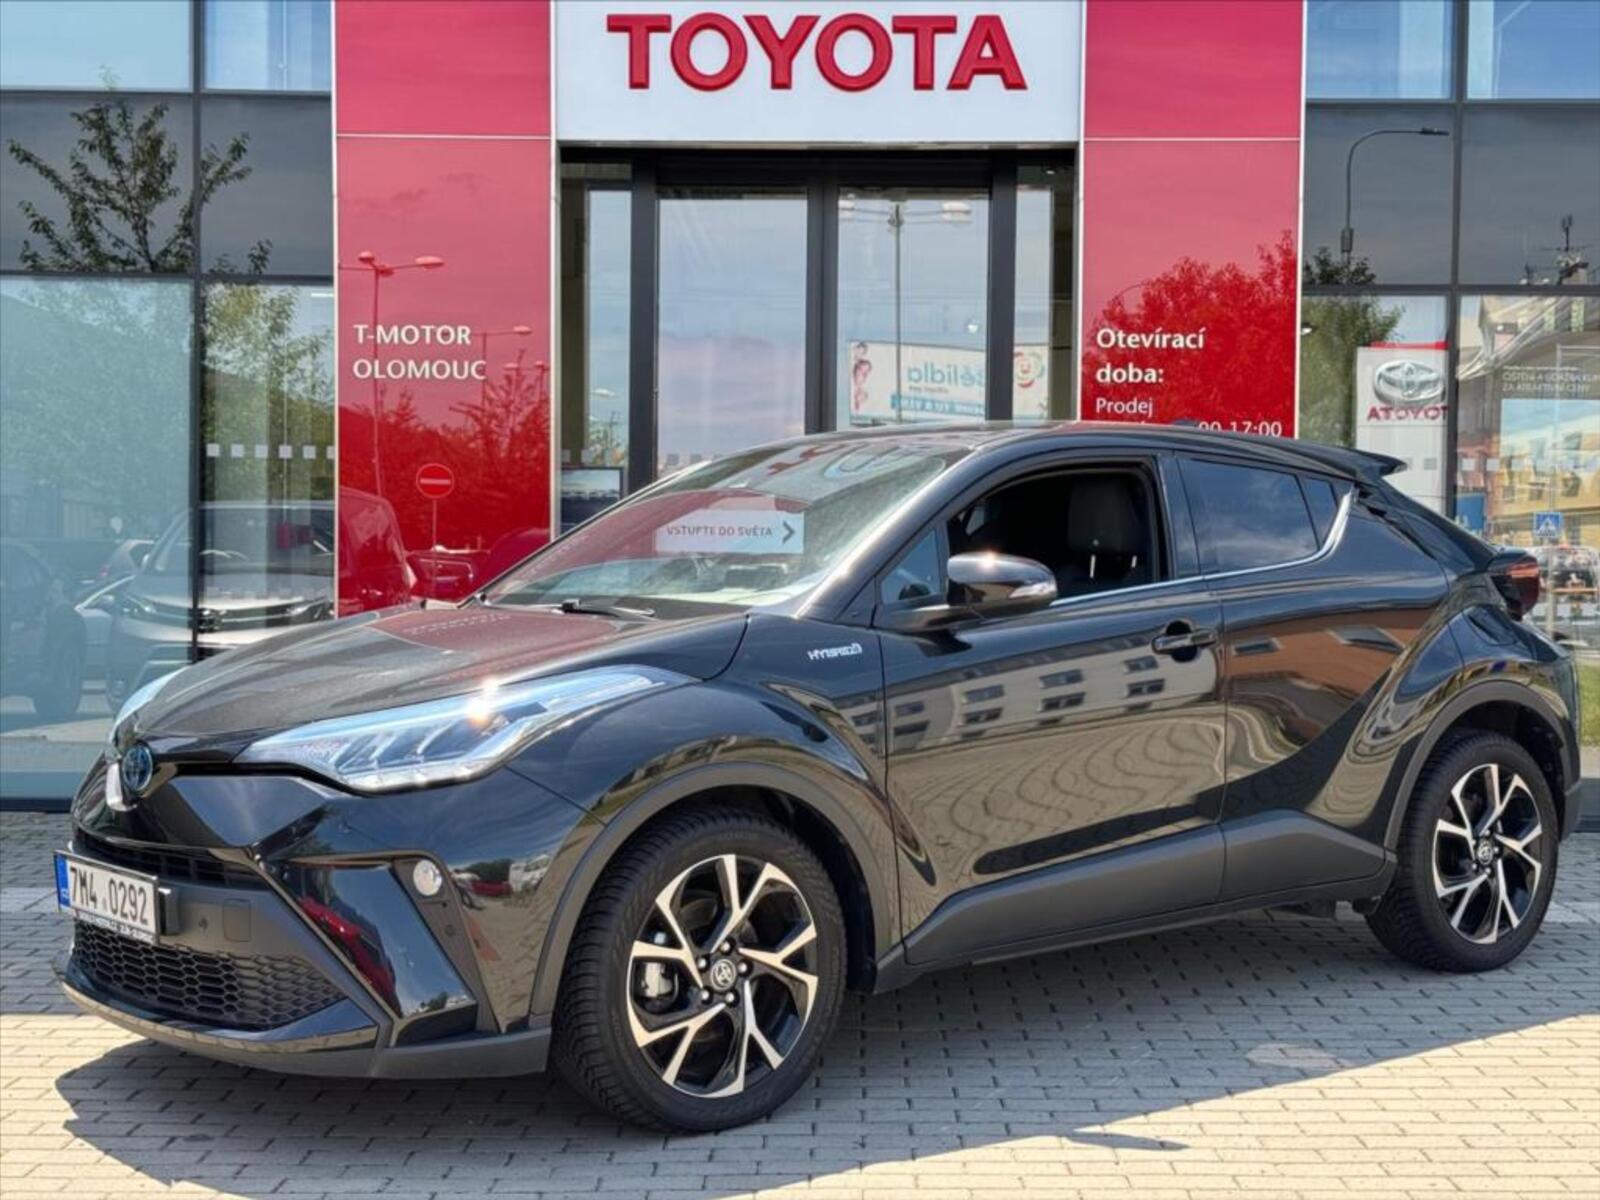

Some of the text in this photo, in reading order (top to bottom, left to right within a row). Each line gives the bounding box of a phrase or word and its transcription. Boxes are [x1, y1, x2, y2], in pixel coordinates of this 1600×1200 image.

[606, 12, 1028, 92] TOYOTA
[353, 325, 472, 345] T-MOTOR
[1096, 327, 1206, 349] Otevírací
[353, 359, 487, 379] OLOMOUC
[1096, 362, 1165, 384] doba:
[1096, 397, 1153, 418] Prodej
[718, 525, 735, 537] DO
[738, 524, 773, 537] SVĚTA
[70, 866, 98, 910] 7M4
[108, 877, 149, 926] 0292
